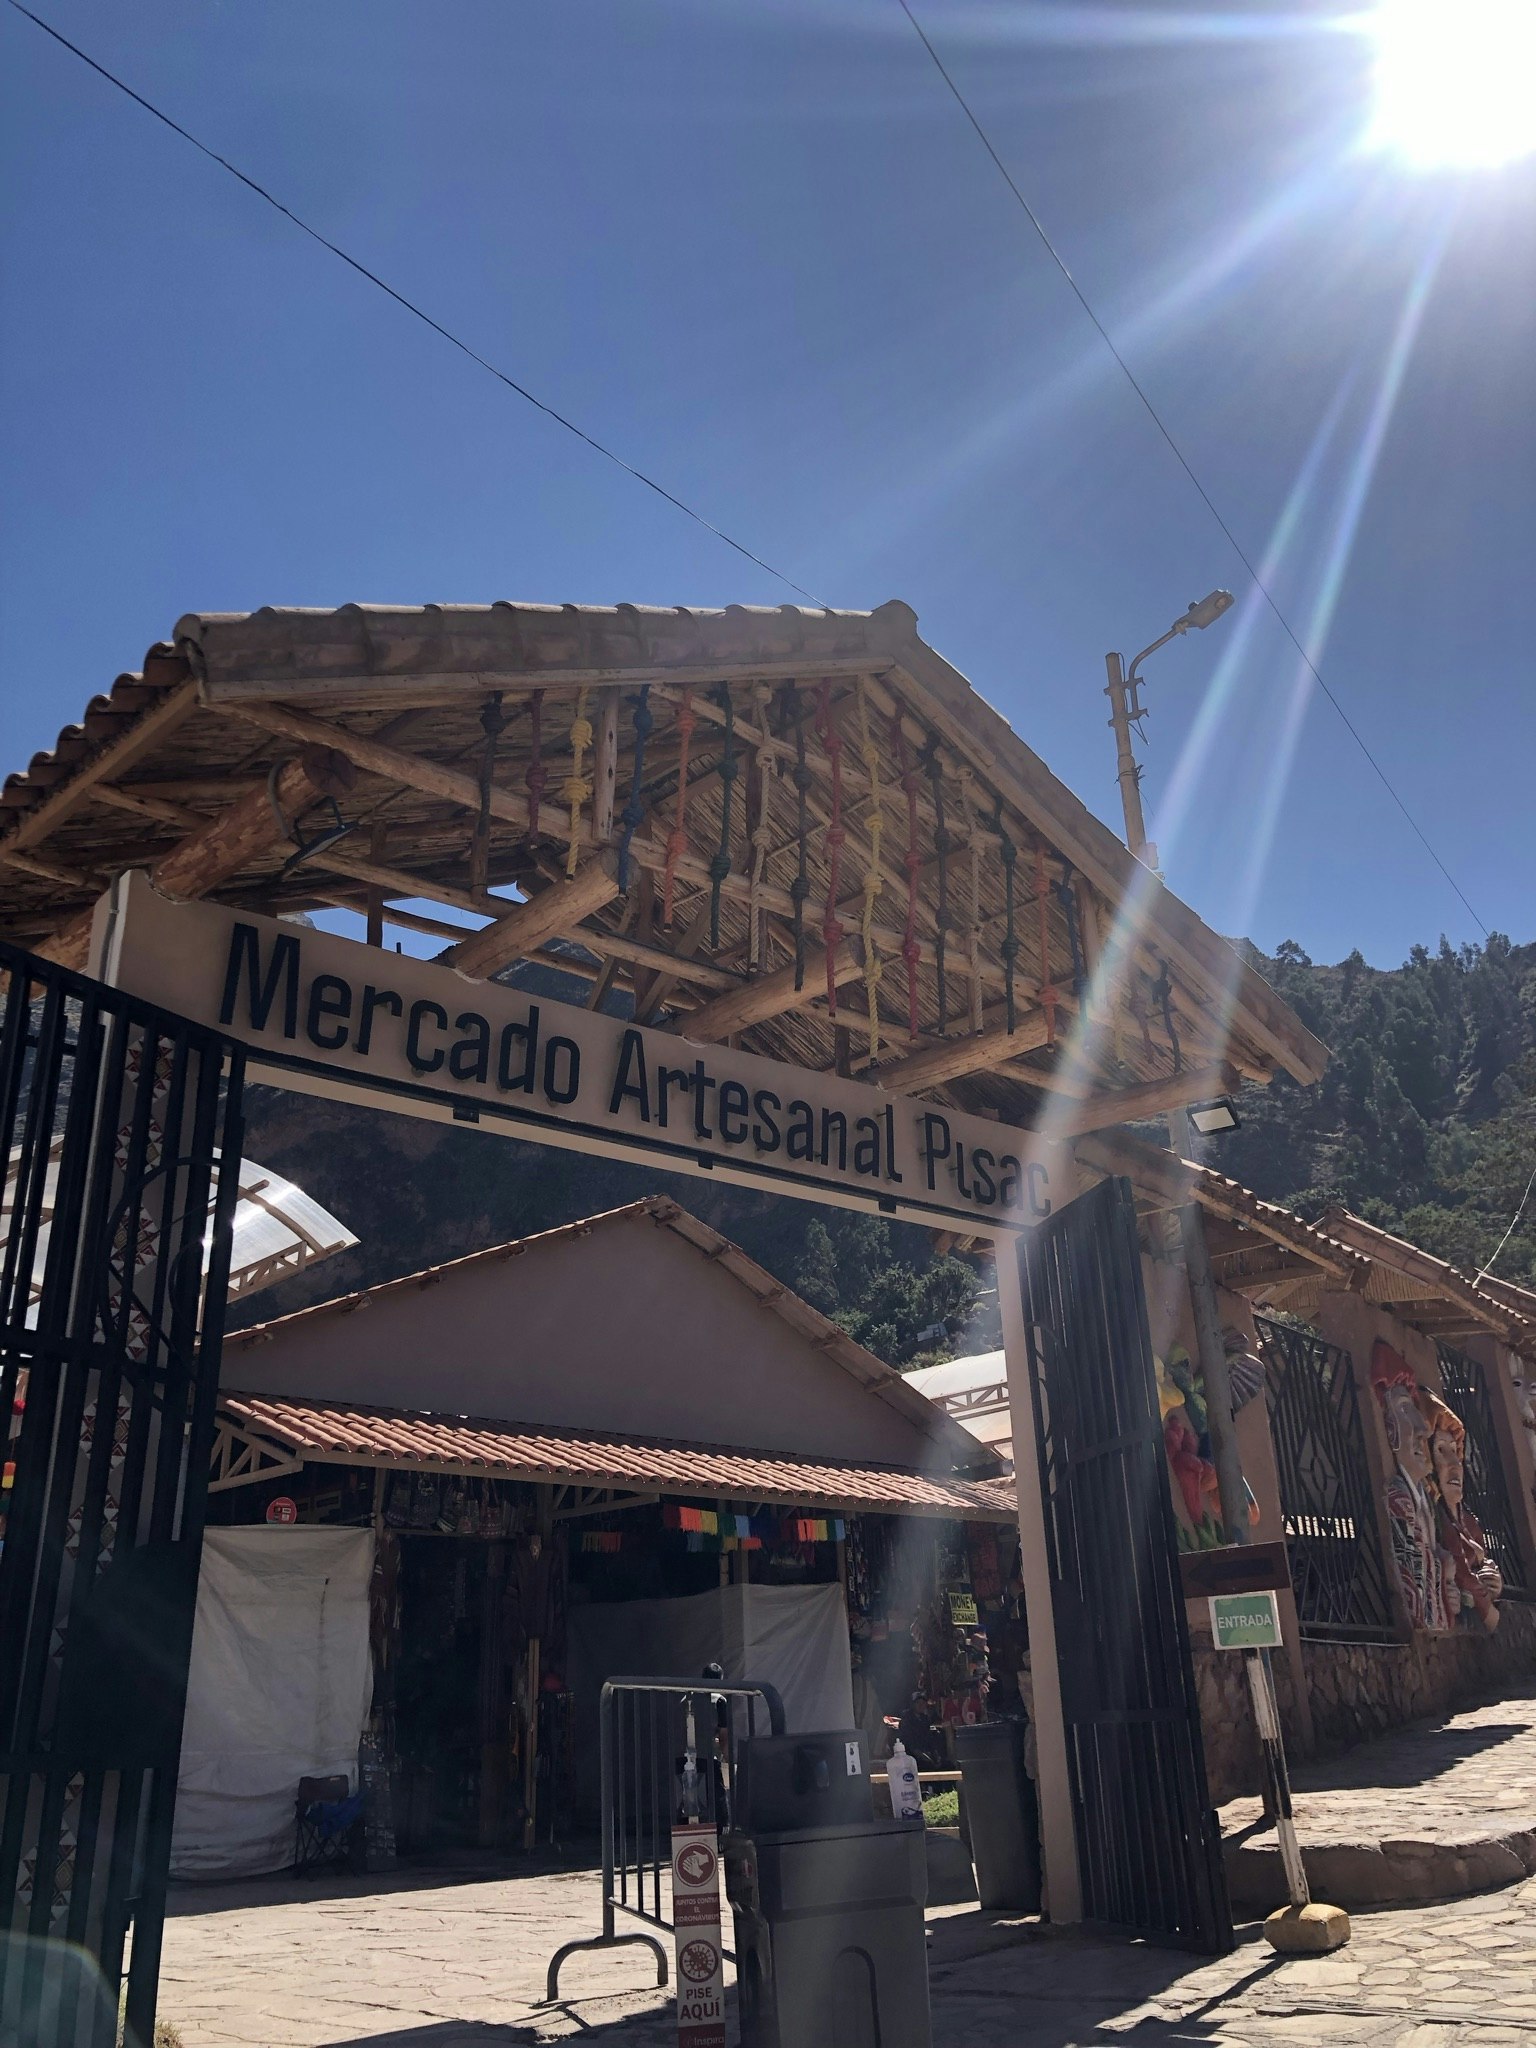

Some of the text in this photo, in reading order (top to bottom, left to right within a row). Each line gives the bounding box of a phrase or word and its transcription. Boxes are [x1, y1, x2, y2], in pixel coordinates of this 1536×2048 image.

[219, 922, 1052, 1218] Mercado Artesanal Pisac
[951, 1595, 974, 1609] MONEY
[953, 1612, 976, 1623] EXCHANGE
[1217, 1614, 1272, 1628] ENTRADA
[675, 1898, 697, 1906] JUNTOS
[675, 1913, 719, 1922] CORONAVIRUS
[686, 1987, 712, 2000] PISE
[680, 1996, 720, 2021] AQUÍ
